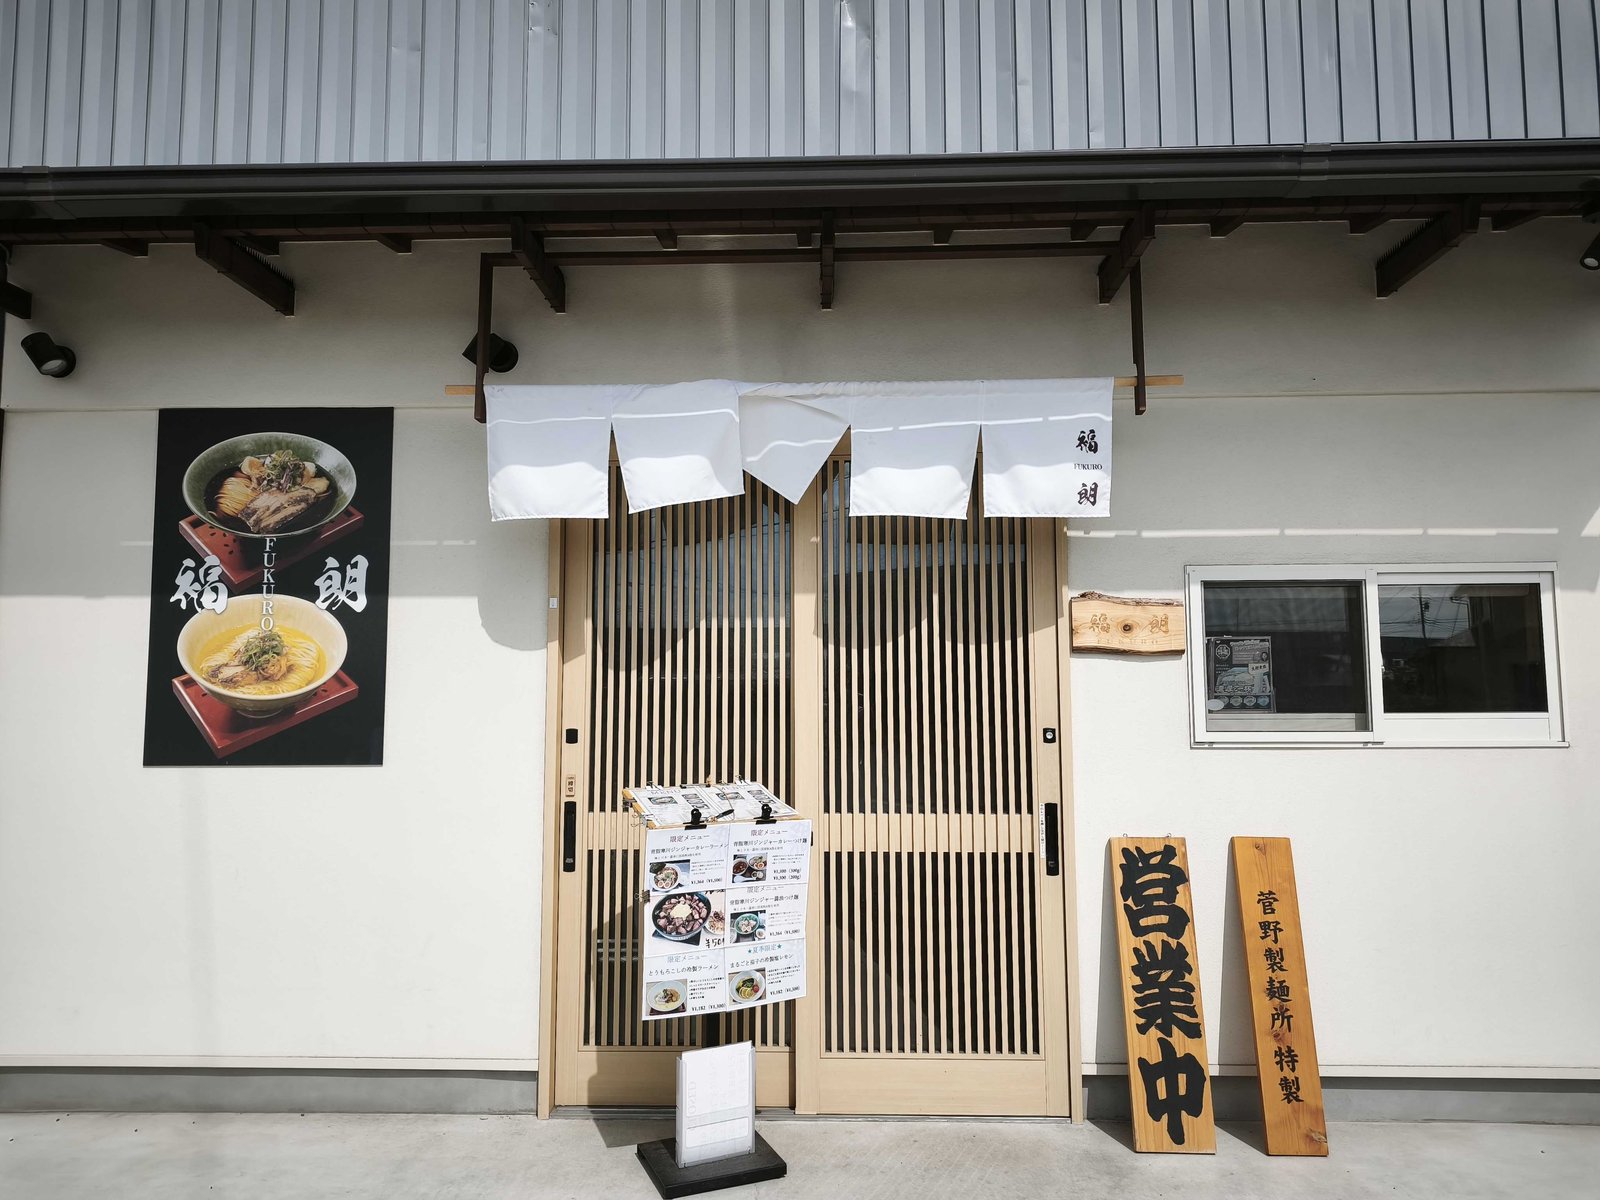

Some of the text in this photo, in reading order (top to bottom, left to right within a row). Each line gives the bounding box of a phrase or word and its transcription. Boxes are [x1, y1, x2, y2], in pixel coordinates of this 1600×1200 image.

[1076, 429, 1098, 454] 福
[1073, 463, 1103, 471] FUKURO
[1077, 482, 1099, 506] 朗
[169, 554, 370, 614] 福 朗
[261, 537, 277, 631] FUKURO
[1118, 844, 1207, 1145] 営業中
